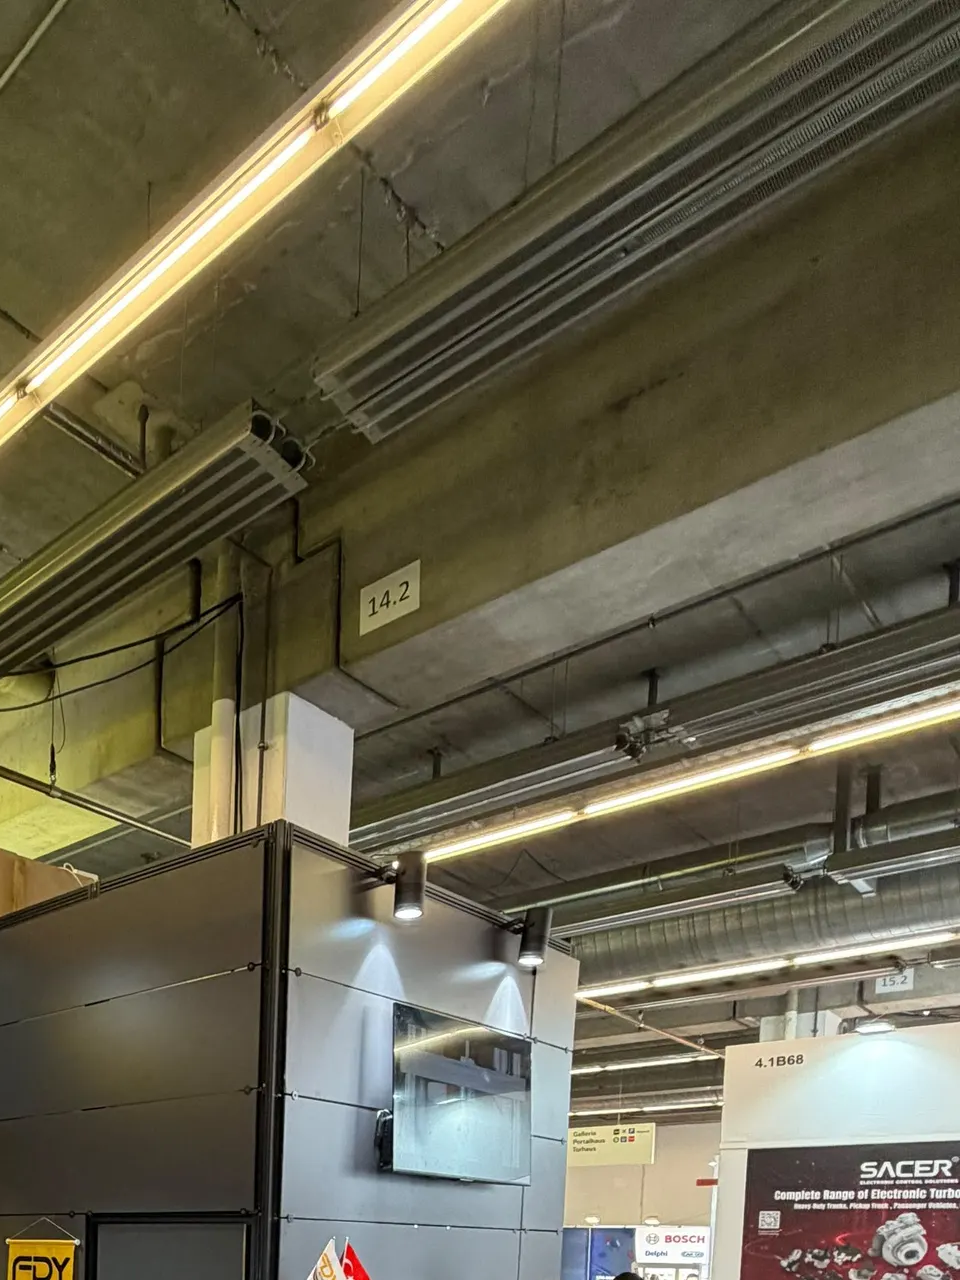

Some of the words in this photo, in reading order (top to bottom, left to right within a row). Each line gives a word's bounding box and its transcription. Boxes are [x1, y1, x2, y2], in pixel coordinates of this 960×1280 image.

[368, 580, 410, 617] 14.2
[881, 975, 908, 987] 15.2
[754, 1054, 804, 1069] 4.1B68
[860, 1160, 953, 1178] SACER
[774, 1190, 821, 1201] Complete
[823, 1189, 856, 1201] Range
[857, 1189, 869, 1200] of
[871, 1188, 928, 1200] Electronic
[664, 1235, 705, 1243] BOSCH
